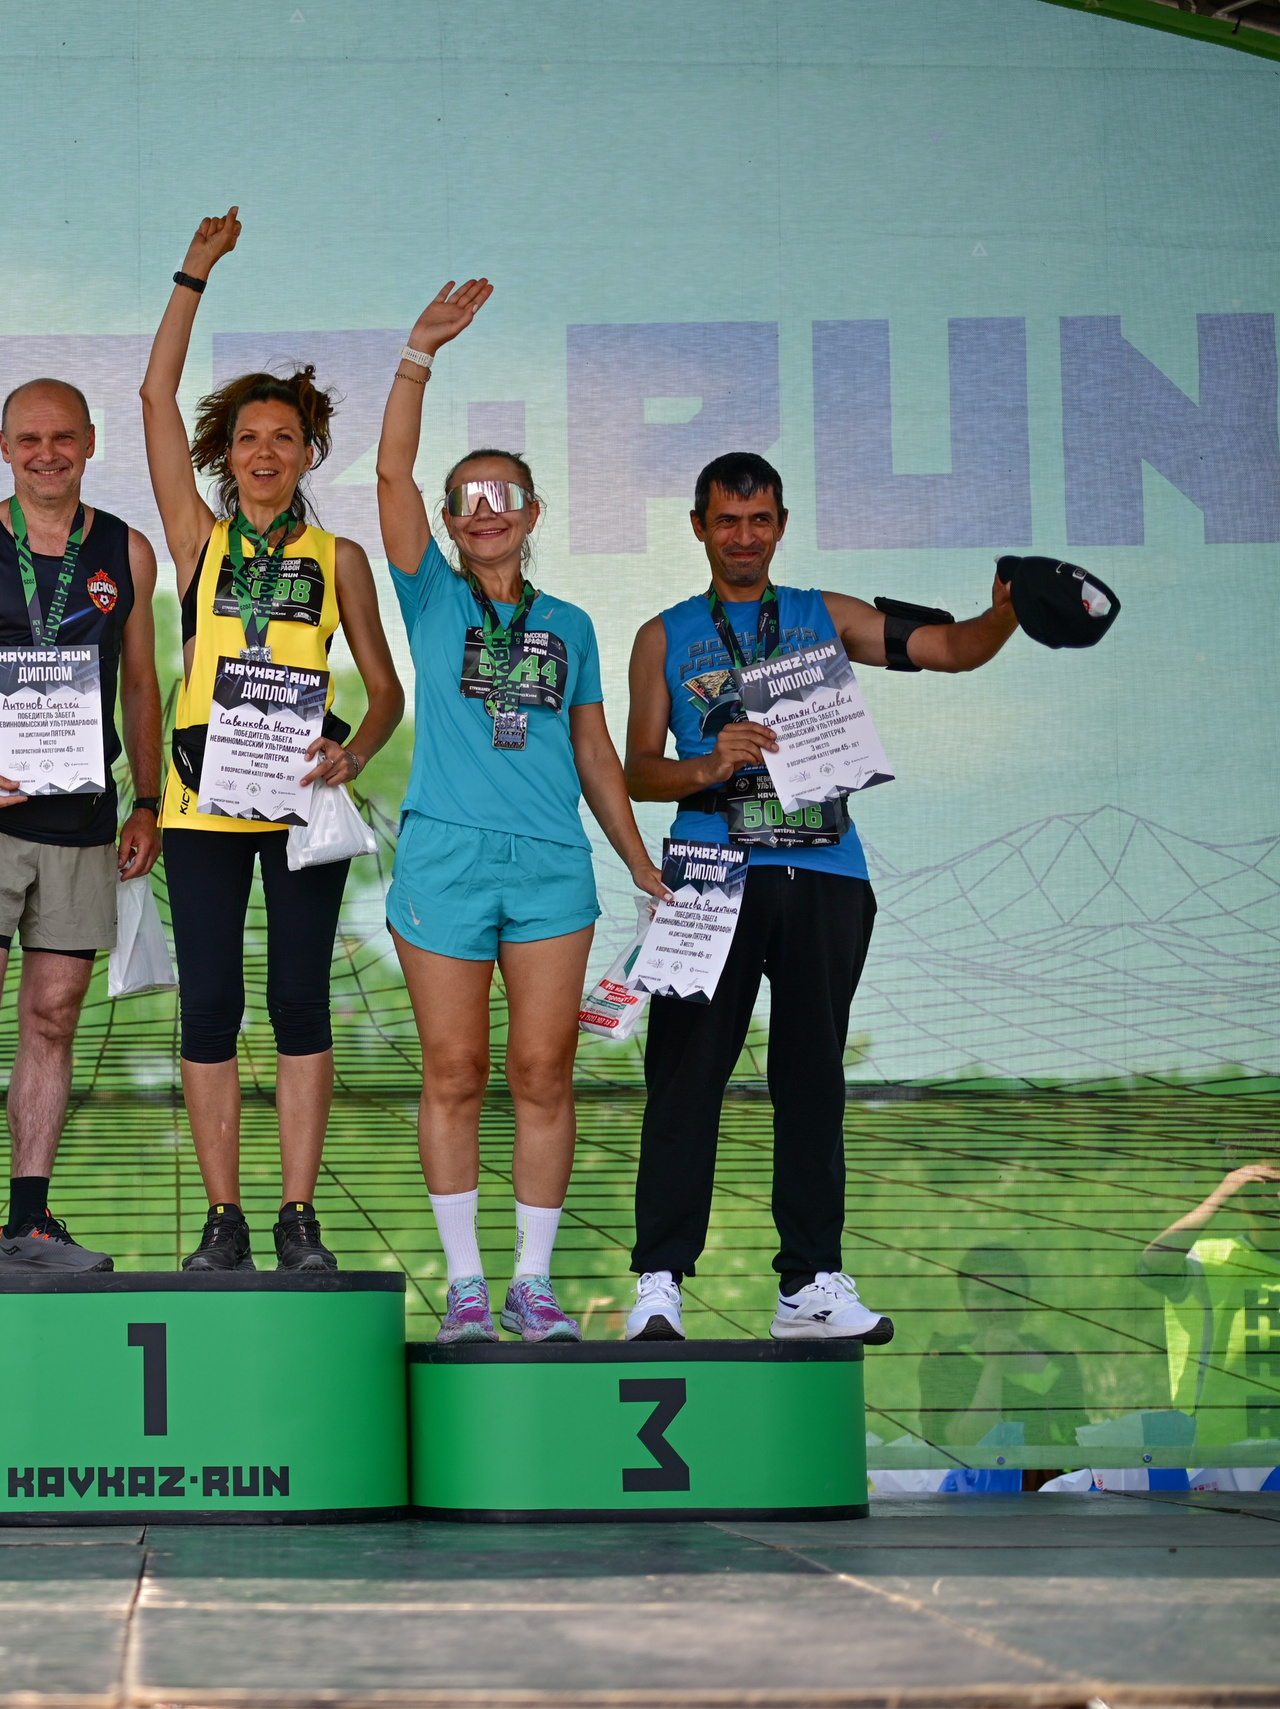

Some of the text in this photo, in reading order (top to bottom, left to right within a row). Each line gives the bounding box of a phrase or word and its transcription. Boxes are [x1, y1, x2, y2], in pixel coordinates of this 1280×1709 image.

[90, 582, 116, 596] ЦСКА
[231, 579, 311, 603] 098
[688, 627, 820, 658] ВОЕНАЯ
[18, 666, 72, 683] ДИПЛОМ
[478, 648, 557, 688] 544
[768, 666, 824, 698] ДИПЛОМ
[241, 682, 298, 704] ДИПЛОМ
[2, 697, 80, 712] Антонов Сергей
[763, 691, 852, 728] Давитьян Самвел
[220, 713, 312, 736] Савенкова Наталья
[780, 709, 840, 732] ПОБЕДИТЕЛЬ ЗАБЕГА
[816, 710, 865, 731] УЛЬТРАМАРАФОН
[210, 734, 264, 749] НЕВИННОМЫССКИЙ
[234, 729, 292, 744] ПОБЕДИТЕЛЬ ЗАБЕГА
[795, 737, 820, 748] ДИСТАНЦИИ
[820, 727, 846, 740] ПЯТЕРКА
[238, 751, 263, 759] ДИСТАНЦИИ
[264, 753, 289, 763] ПЯТЕРКА
[790, 755, 817, 767] ВОЗРАСТНОЙ
[817, 749, 841, 759] КАТЕГОРИИ
[224, 766, 251, 775] ВОЗРАСТНОЙ
[252, 770, 276, 778] КАТЕГОРИИ
[684, 862, 727, 882] ДИПЛОМ
[674, 910, 718, 922] ПОБЕДИТЕЛЬ ЗАБЕГА
[702, 900, 738, 915] Валентина
[655, 917, 732, 934] НЕВИННОМЫССКИЙ УЛЬТРАМАРАФОН
[126, 1322, 167, 1436] 1
[618, 1378, 690, 1492] 3
